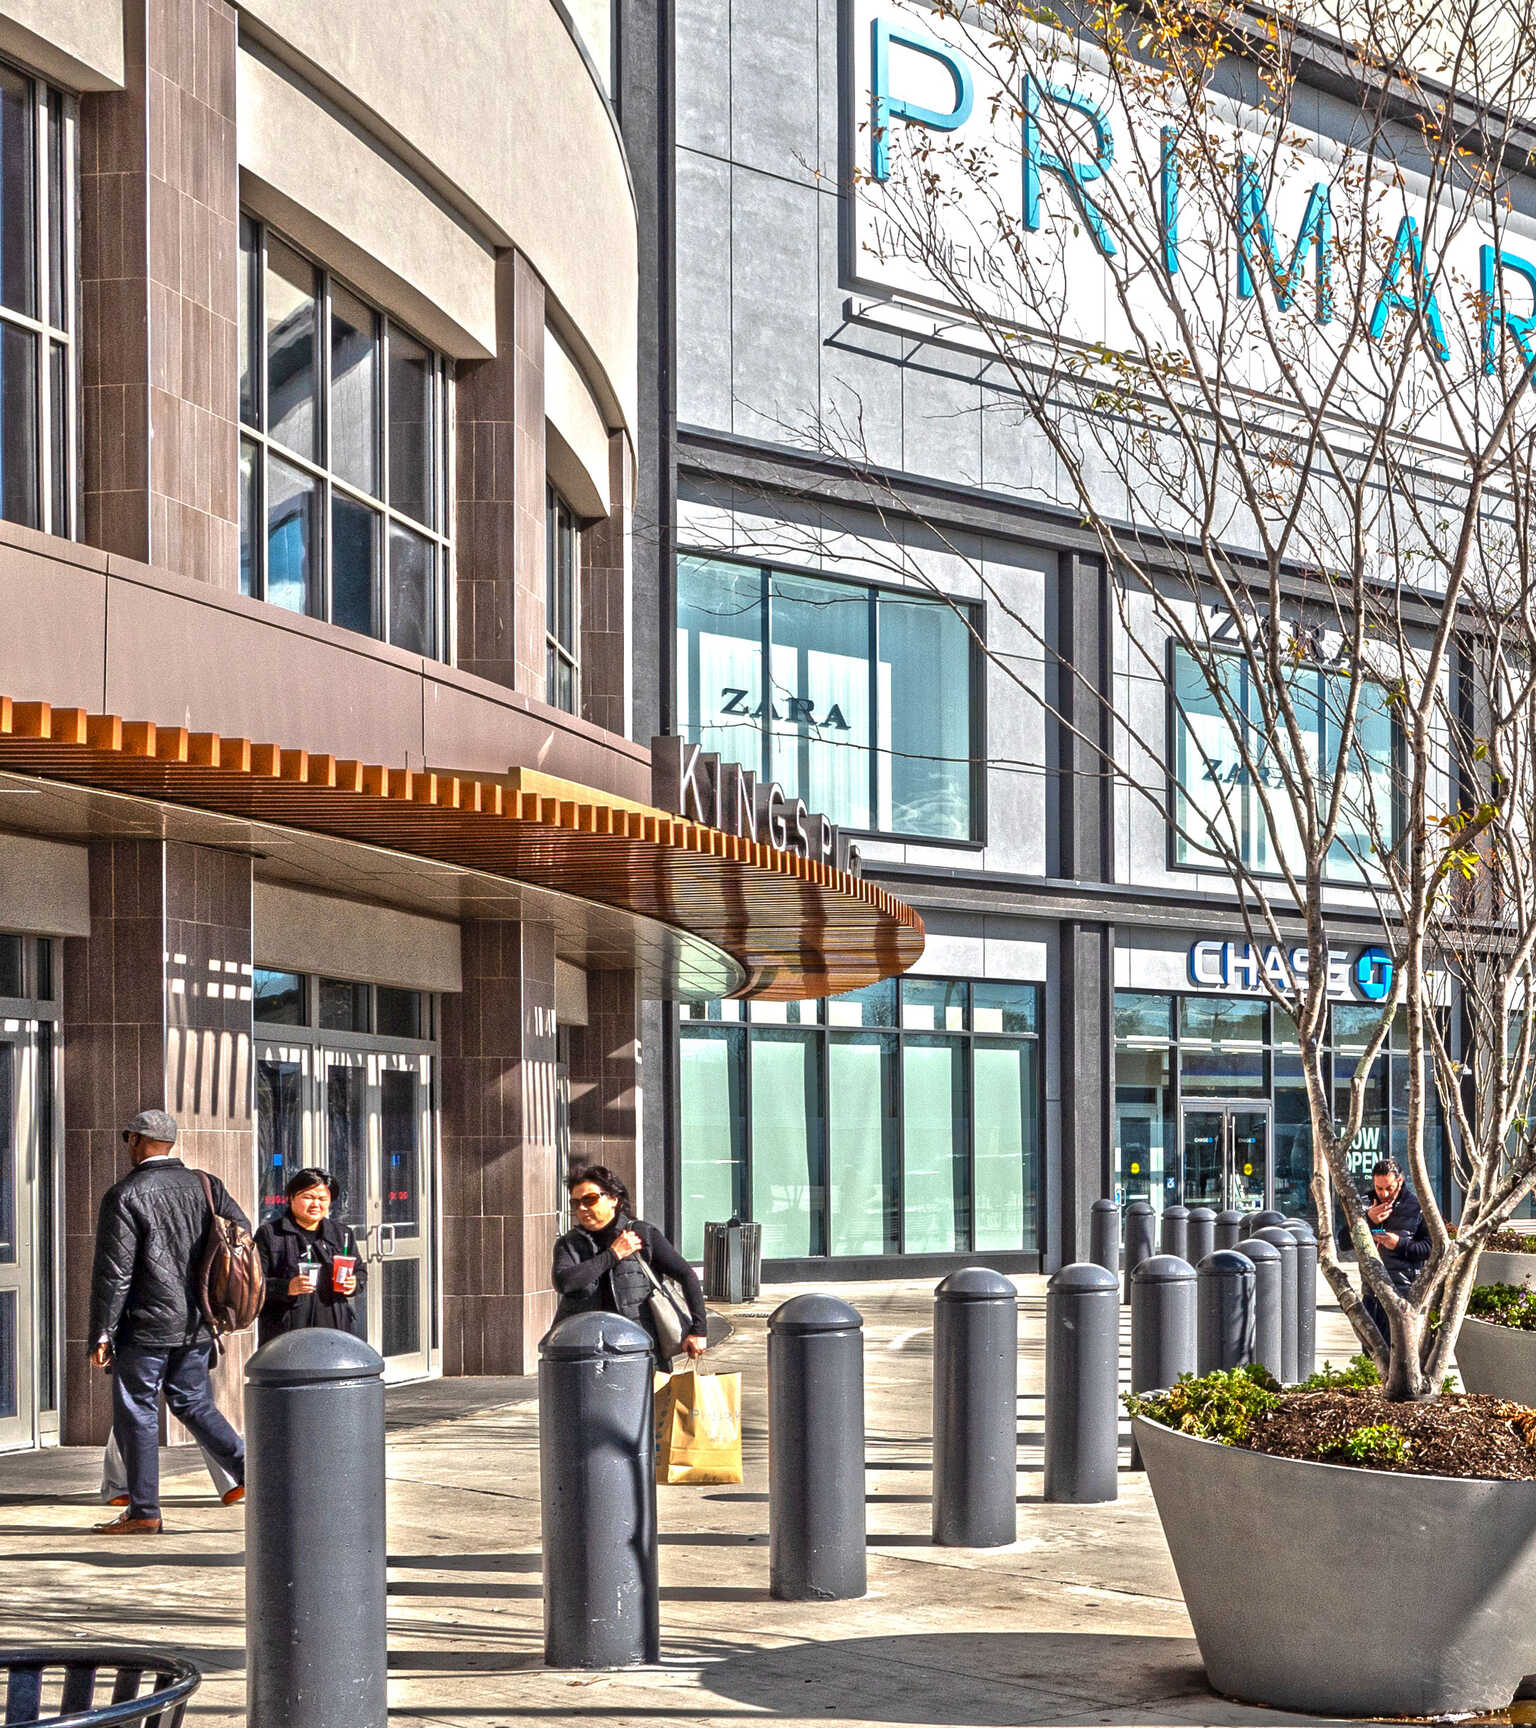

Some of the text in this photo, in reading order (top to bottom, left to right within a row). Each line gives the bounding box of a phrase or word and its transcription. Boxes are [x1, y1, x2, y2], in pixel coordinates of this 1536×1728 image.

[720, 687, 851, 731] ZARA
[676, 735, 809, 859] KINGS
[1191, 940, 1350, 995] CHASE
[1346, 1151, 1383, 1173] OPEN
